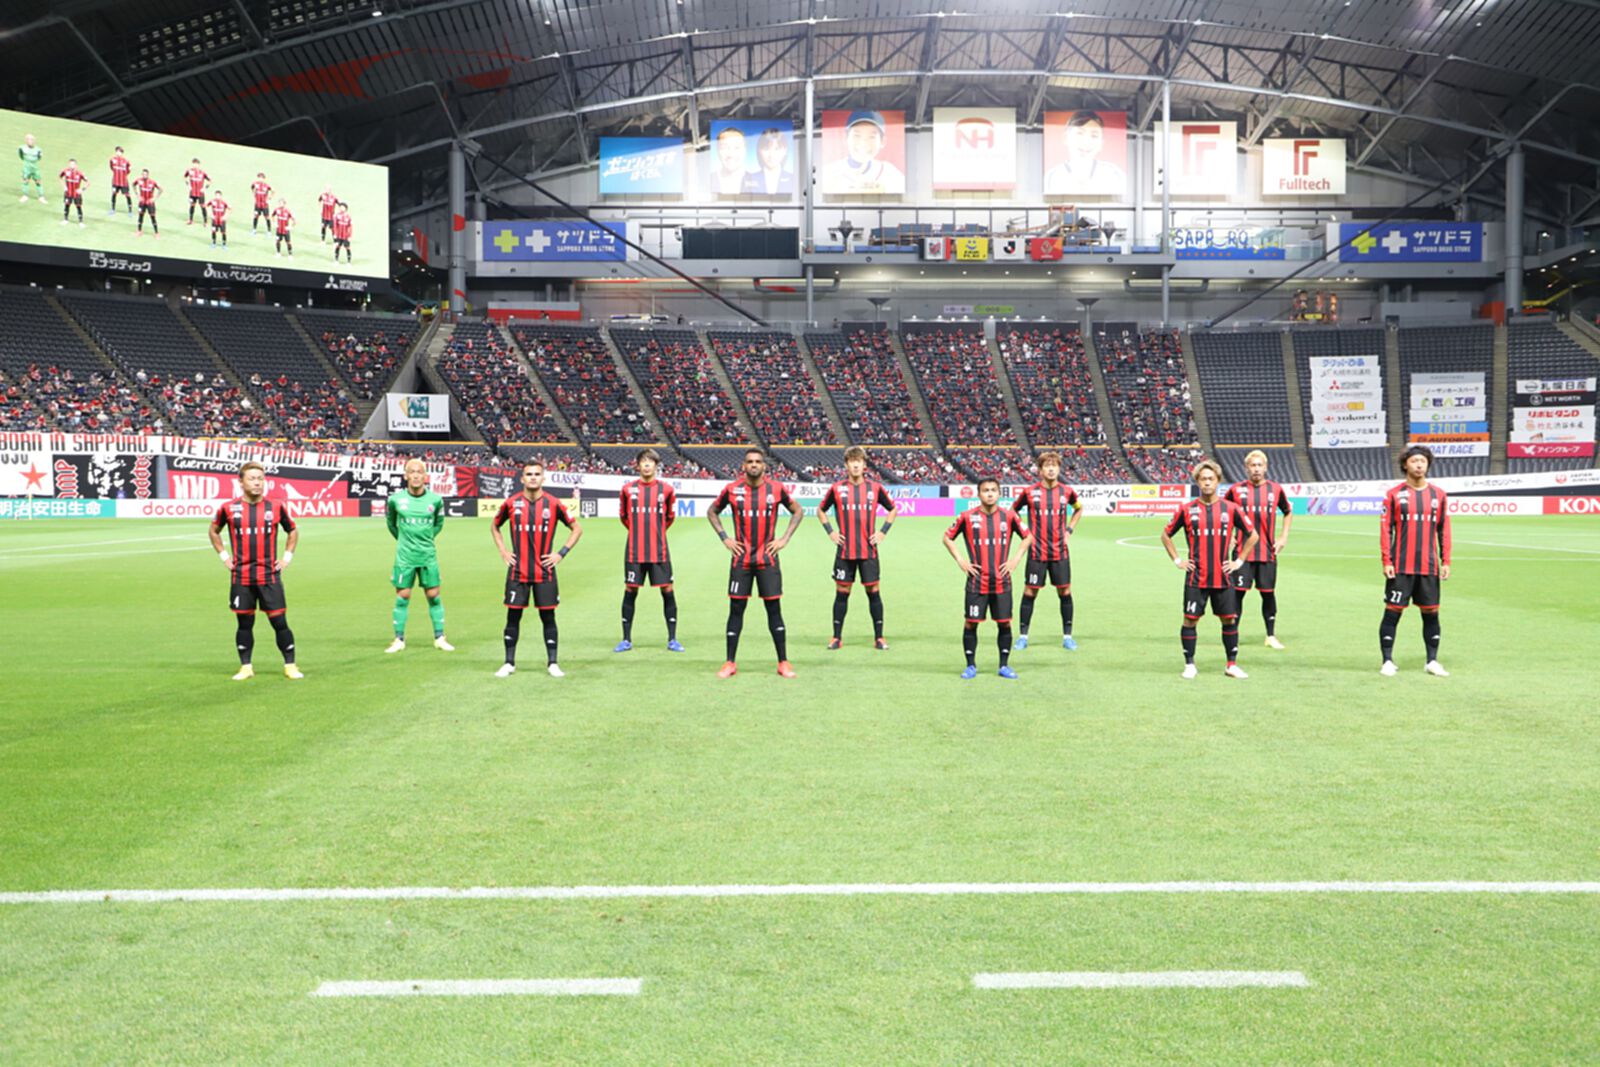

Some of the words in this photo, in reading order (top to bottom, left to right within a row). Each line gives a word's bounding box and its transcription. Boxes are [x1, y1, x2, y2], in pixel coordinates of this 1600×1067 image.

[1279, 178, 1331, 191] Fulltech
[556, 229, 616, 244] サツドラ
[1413, 230, 1472, 245] サツドラ
[229, 269, 273, 284] ベルックス
[1337, 412, 1378, 423] yokorei
[1528, 409, 1580, 418] リポビタンD
[392, 420, 409, 428] Love
[419, 421, 446, 430] Sweets
[161, 435, 197, 455] LIVE
[1449, 444, 1476, 455] RACE
[1537, 445, 1581, 454] アイングループ
[551, 473, 585, 485] CLASSIC
[1077, 487, 1130, 499] スポーツくじ
[1304, 484, 1358, 495] あいプラン
[0, 501, 101, 516] 明治安田生命
[142, 501, 213, 516] docomo
[1448, 498, 1518, 513] docomo
[1559, 498, 1600, 513] KON
[730, 580, 739, 593] 11
[1238, 576, 1244, 587] 5
[233, 595, 240, 608] 4
[510, 590, 516, 603] 7
[1390, 590, 1402, 603] 27
[1186, 600, 1197, 613] 14
